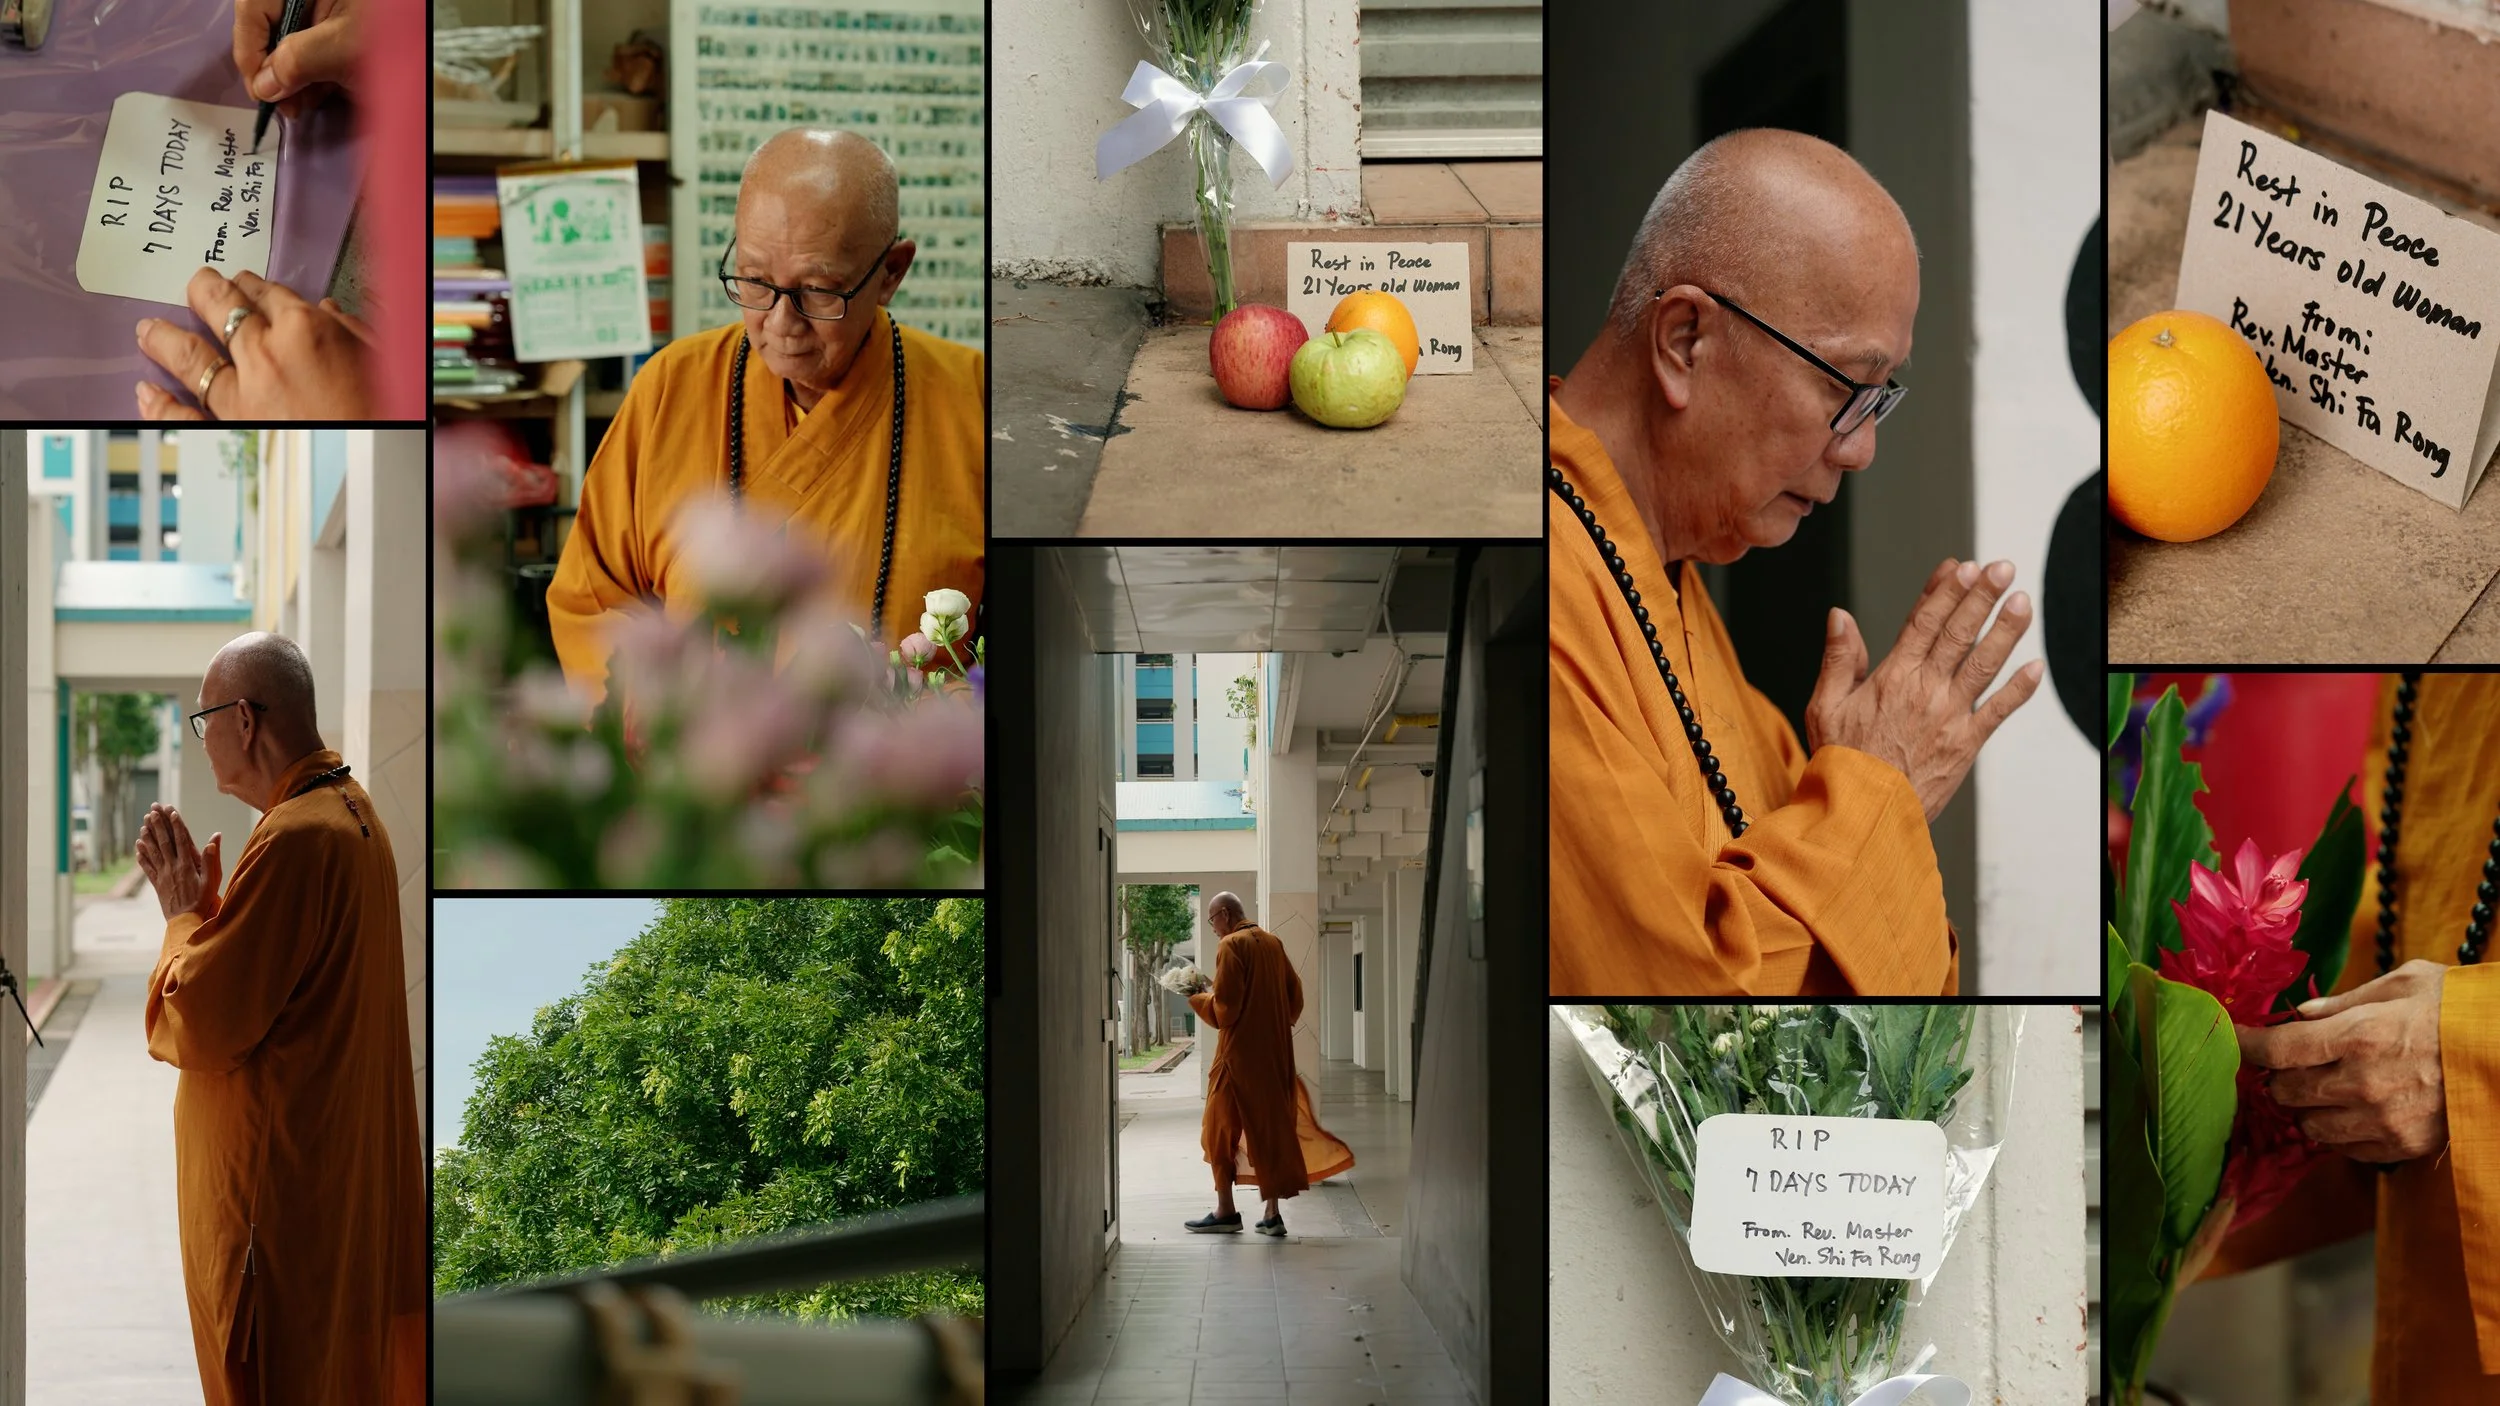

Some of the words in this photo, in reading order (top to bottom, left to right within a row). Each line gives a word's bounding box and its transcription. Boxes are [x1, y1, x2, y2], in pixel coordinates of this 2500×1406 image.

[160, 117, 192, 176] TODAY
[213, 127, 240, 178] Master
[244, 161, 265, 178] Fa
[240, 181, 263, 203] Shi
[2236, 139, 2302, 208] Rest
[2312, 189, 2339, 228] in
[2361, 201, 2441, 268] Peace
[148, 184, 184, 234] DAYS
[238, 207, 261, 239] Ven.
[142, 241, 173, 254] 7
[1310, 248, 1352, 272] Rest
[1359, 255, 1376, 272] in
[1386, 250, 1433, 270] Peace
[2212, 190, 2246, 234] 21
[2250, 210, 2327, 272] Years
[2336, 258, 2387, 299] old
[2391, 279, 2483, 341] Woman
[1302, 275, 1322, 296] 21
[1380, 277, 1408, 294] old
[1412, 278, 1461, 294] Woman
[2229, 295, 2276, 348] Rev.
[2280, 323, 2369, 386] Master
[2301, 299, 2374, 357] From:
[1429, 337, 1462, 363] Rong
[2308, 373, 2347, 416] Shi
[2354, 395, 2382, 437] Fa
[2393, 410, 2452, 479] Rong
[1745, 1166, 1759, 1193] 7
[1769, 1169, 1829, 1197] DAYS
[1837, 1172, 1918, 1197] TODAY
[1845, 1220, 1914, 1242] Master
[1774, 1247, 1812, 1268] Ven.
[1816, 1246, 1847, 1267] Shi
[1850, 1248, 1873, 1268] Fa
[1877, 1245, 1922, 1274] Rong
